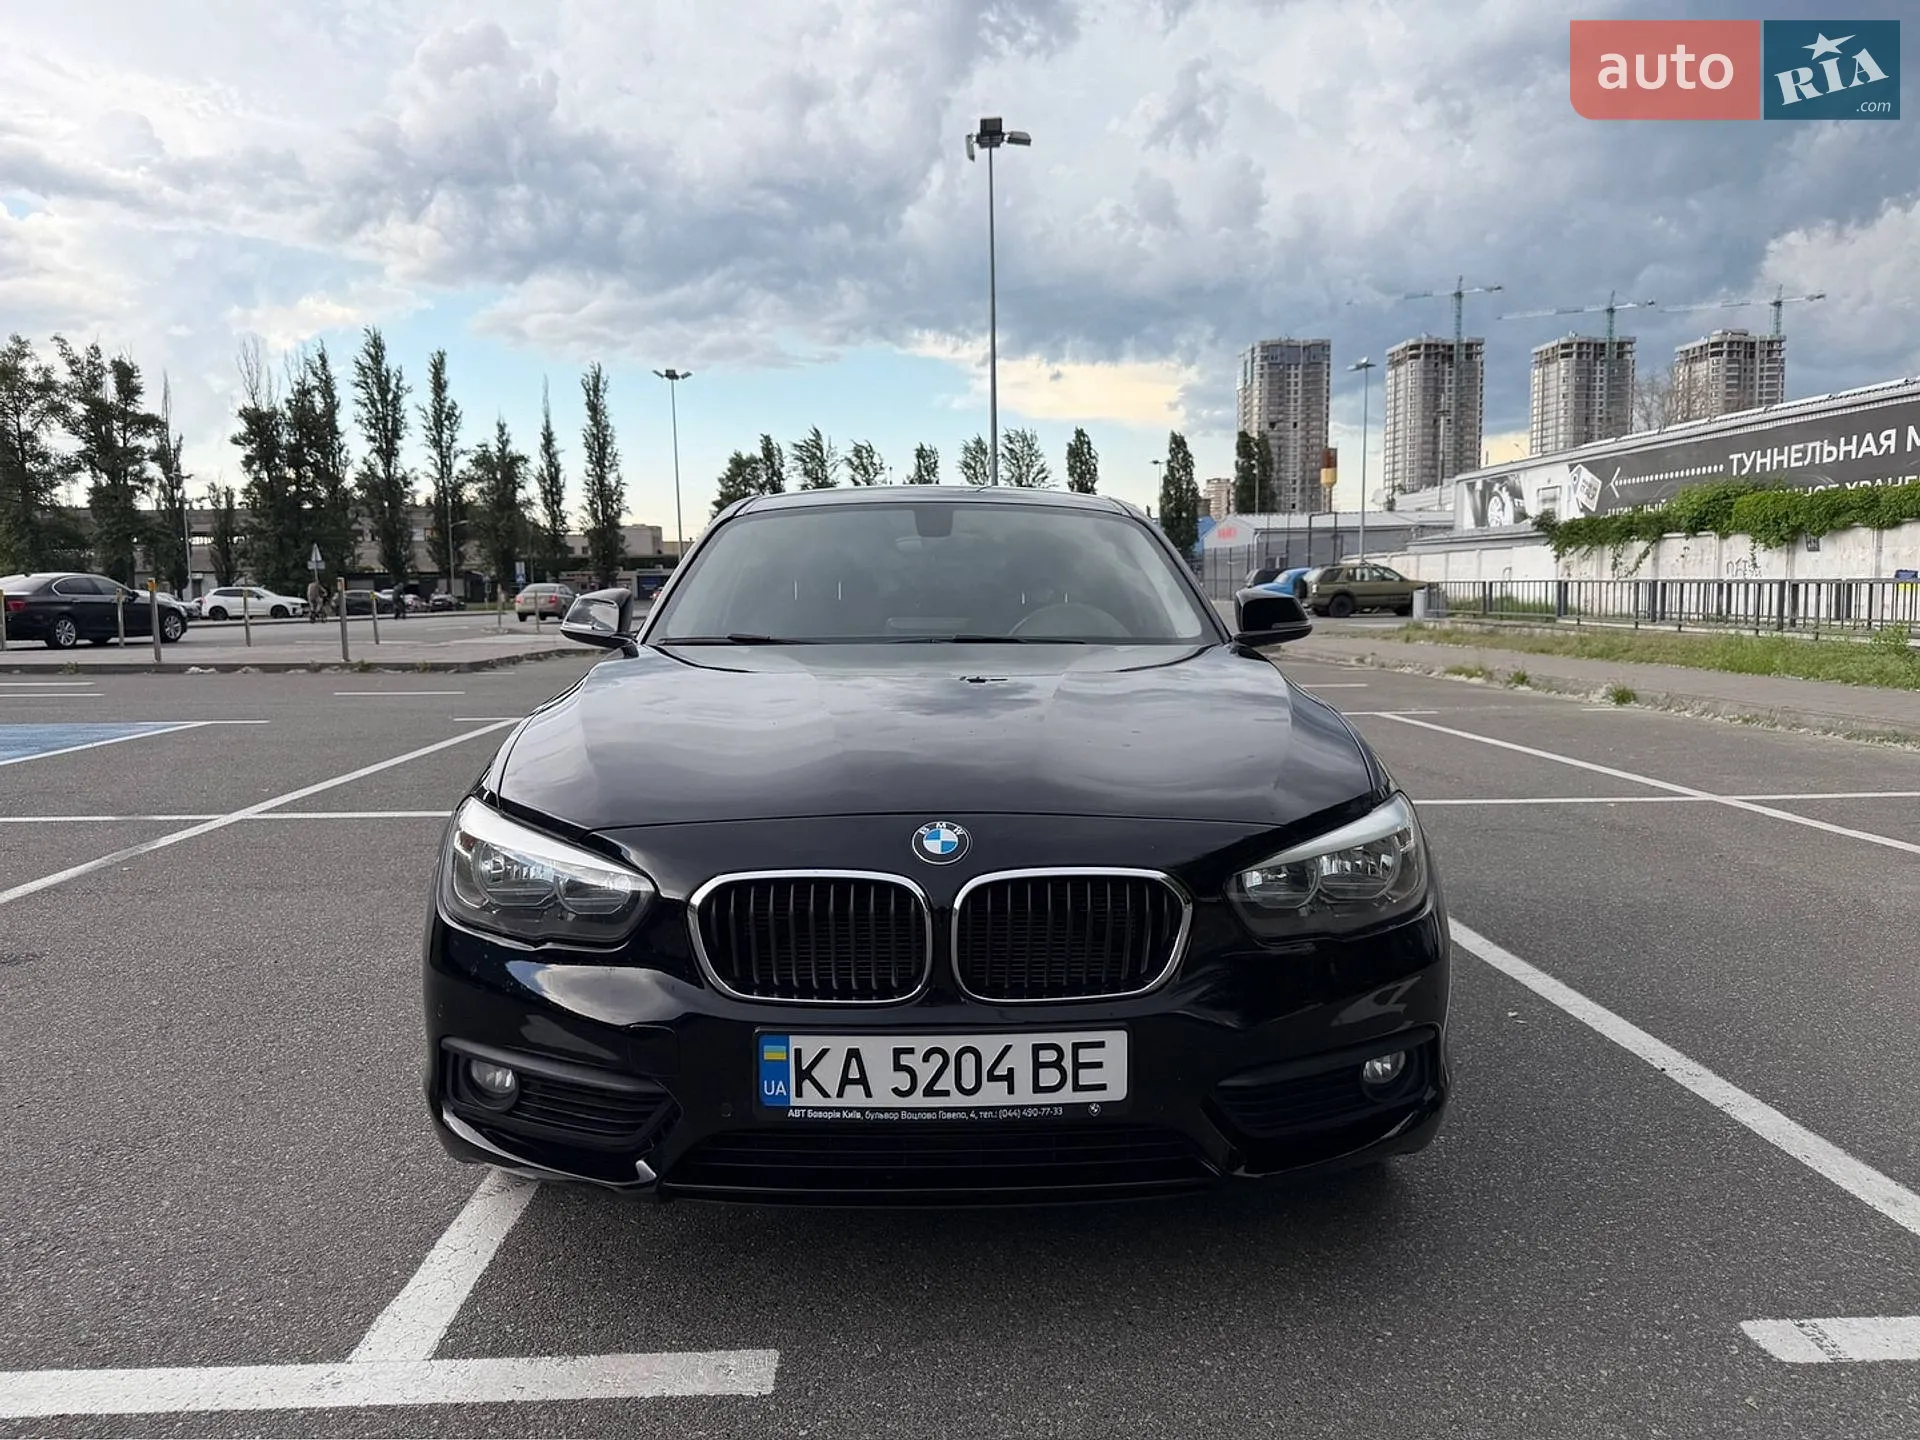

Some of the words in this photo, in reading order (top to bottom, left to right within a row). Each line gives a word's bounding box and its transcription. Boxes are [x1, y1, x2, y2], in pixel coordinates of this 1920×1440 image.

[1729, 428, 1897, 476] ТУННЕЛЬНАЯ
[793, 1047, 873, 1099] KA
[890, 1044, 1016, 1098] 5204
[1031, 1040, 1108, 1095] BE
[763, 1080, 787, 1096] UA
[998, 1108, 1021, 1120] (044)
